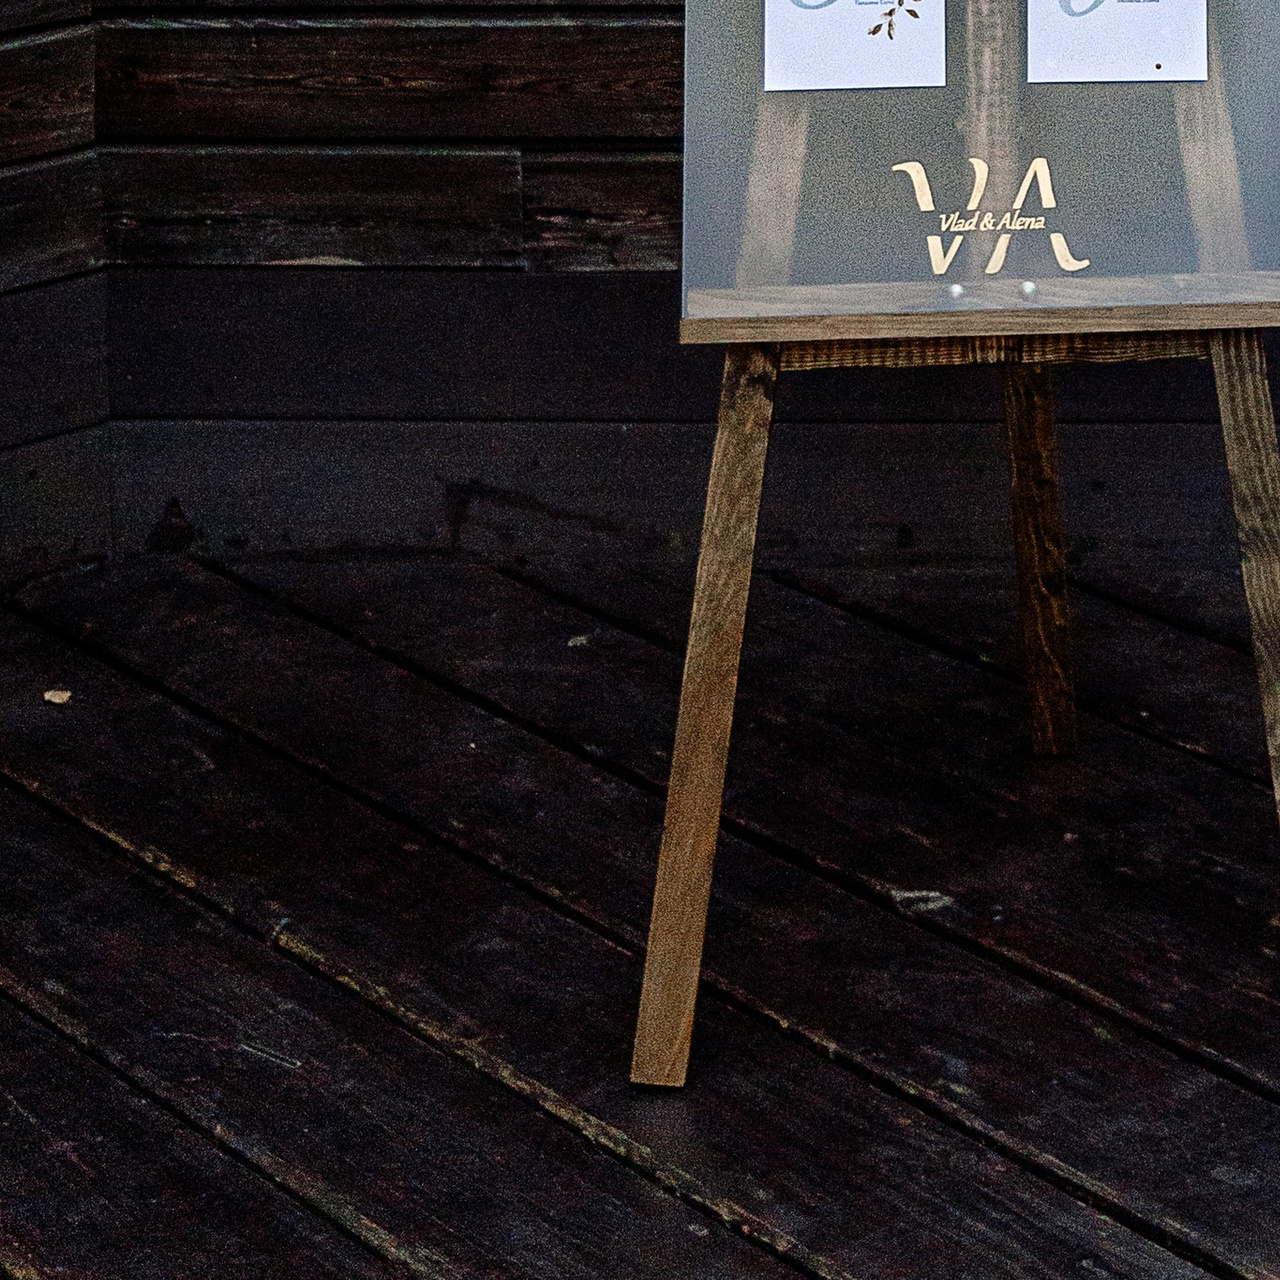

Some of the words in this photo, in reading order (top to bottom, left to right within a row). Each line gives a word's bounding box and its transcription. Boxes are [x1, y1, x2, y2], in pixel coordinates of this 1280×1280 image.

[939, 211, 980, 232] Vlad
[979, 212, 996, 231] &
[997, 209, 1046, 231] Alena
